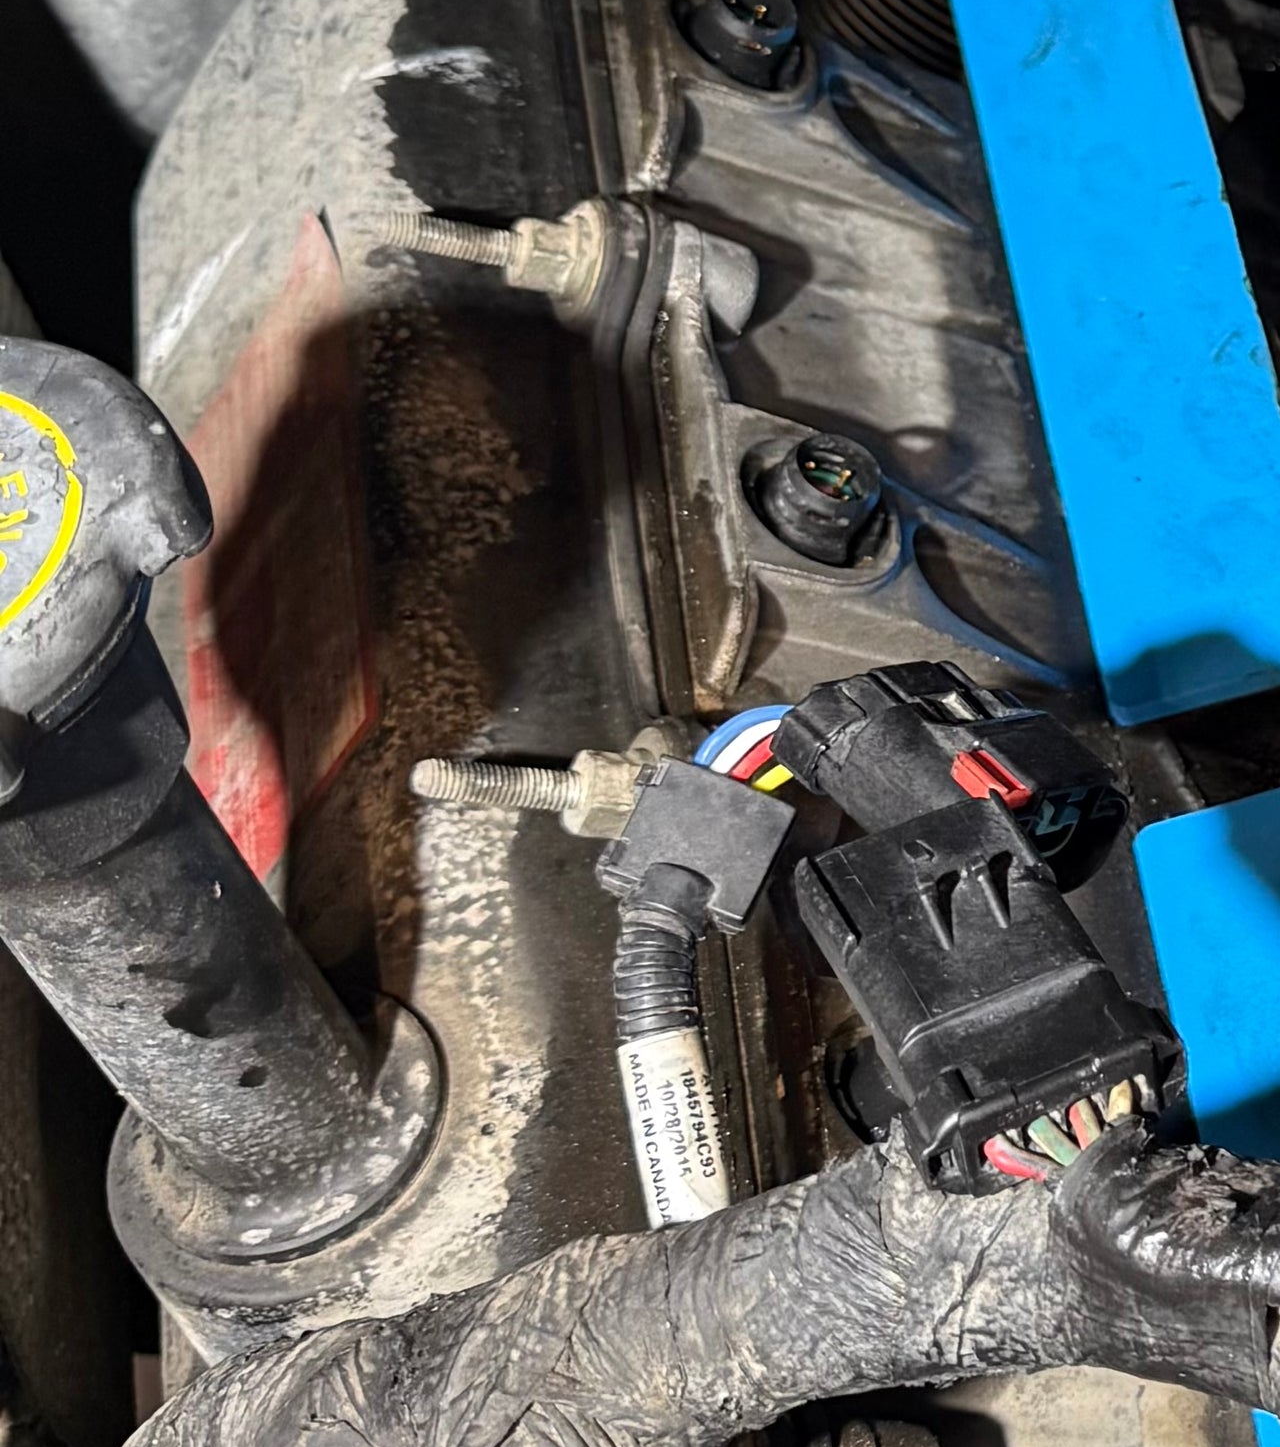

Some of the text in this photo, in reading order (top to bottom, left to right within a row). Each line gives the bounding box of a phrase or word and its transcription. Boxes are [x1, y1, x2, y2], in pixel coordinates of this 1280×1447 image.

[628, 1053, 672, 1224] MADE IN CANADA
[679, 1067, 716, 1178] 1845794C93
